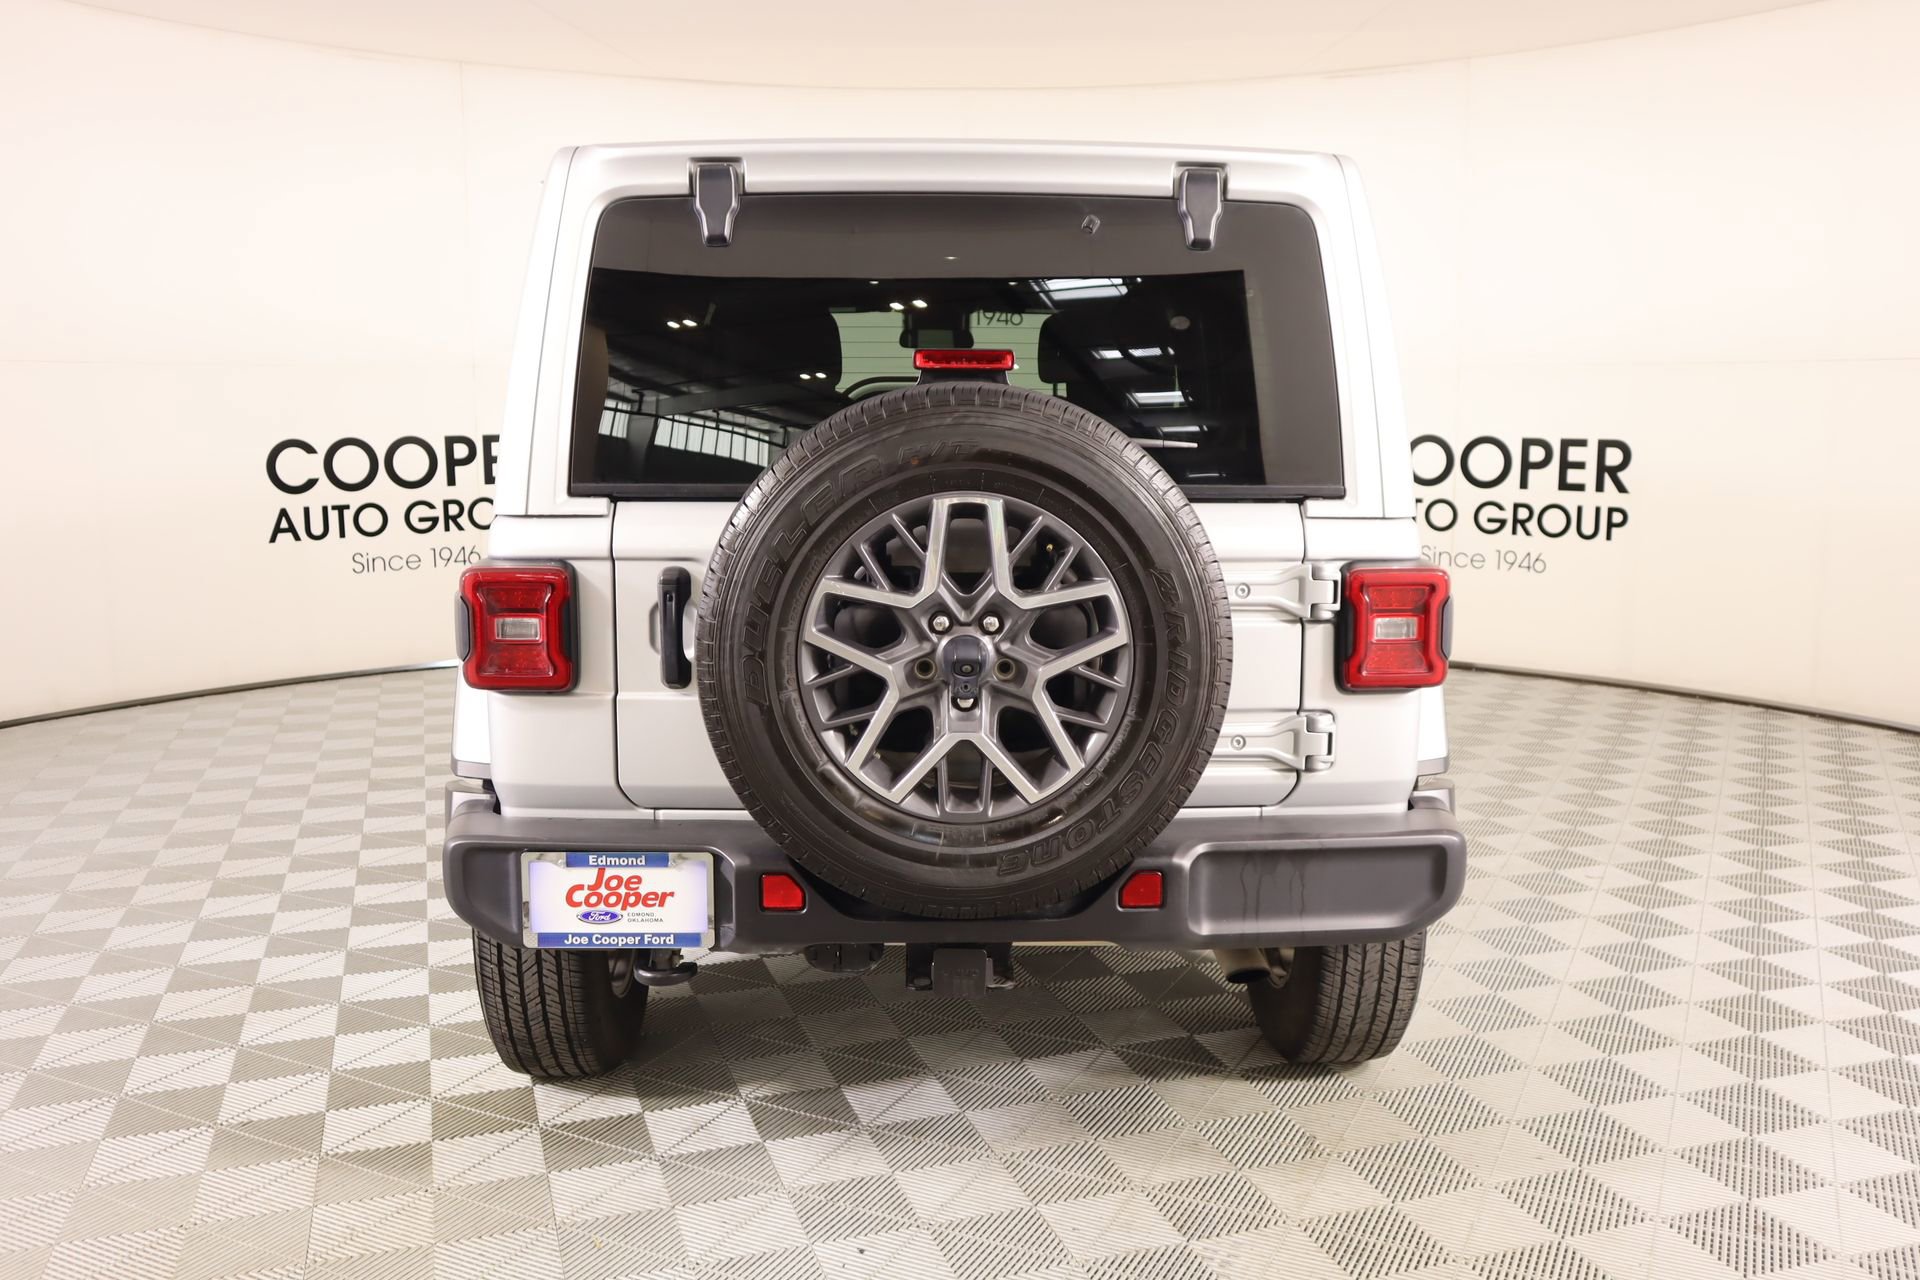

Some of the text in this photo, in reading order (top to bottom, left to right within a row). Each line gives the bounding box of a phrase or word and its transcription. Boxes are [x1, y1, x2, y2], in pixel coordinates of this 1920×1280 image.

[266, 434, 500, 495] COOPE
[1410, 434, 1632, 494] OOPER
[268, 497, 494, 543] AUTO GRO
[1473, 500, 1629, 541] GROUP
[352, 545, 482, 574] Since 1946
[1421, 544, 1547, 574] Since 1946
[997, 568, 1193, 877] BRIDGESTONE
[588, 854, 646, 866] Edmond
[587, 867, 643, 892] Joe
[565, 884, 675, 911] Cooper
[564, 934, 674, 947] Joe Cooper Ford
